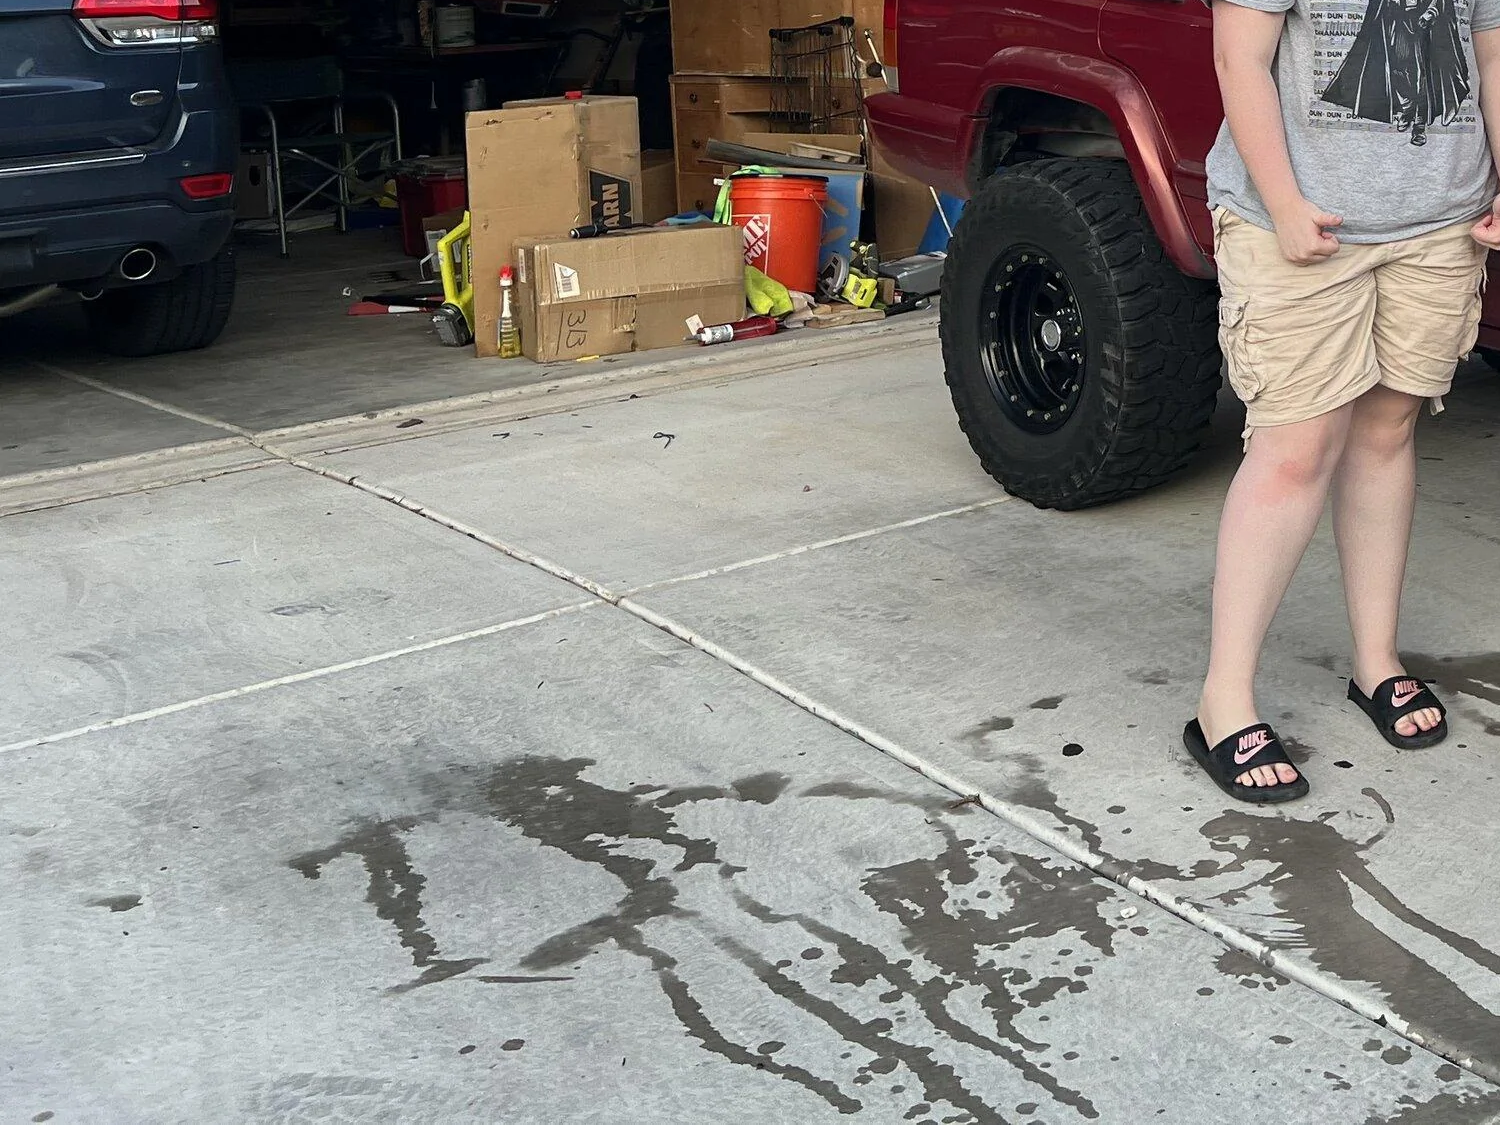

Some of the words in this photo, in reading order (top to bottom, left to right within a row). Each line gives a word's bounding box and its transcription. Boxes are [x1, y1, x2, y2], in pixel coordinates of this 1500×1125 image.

[1326, 12, 1343, 20] DUN
[1347, 13, 1363, 21] DUN
[602, 183, 620, 228] ARN
[1394, 679, 1419, 697] NIKE
[1238, 729, 1268, 752] NIKE
